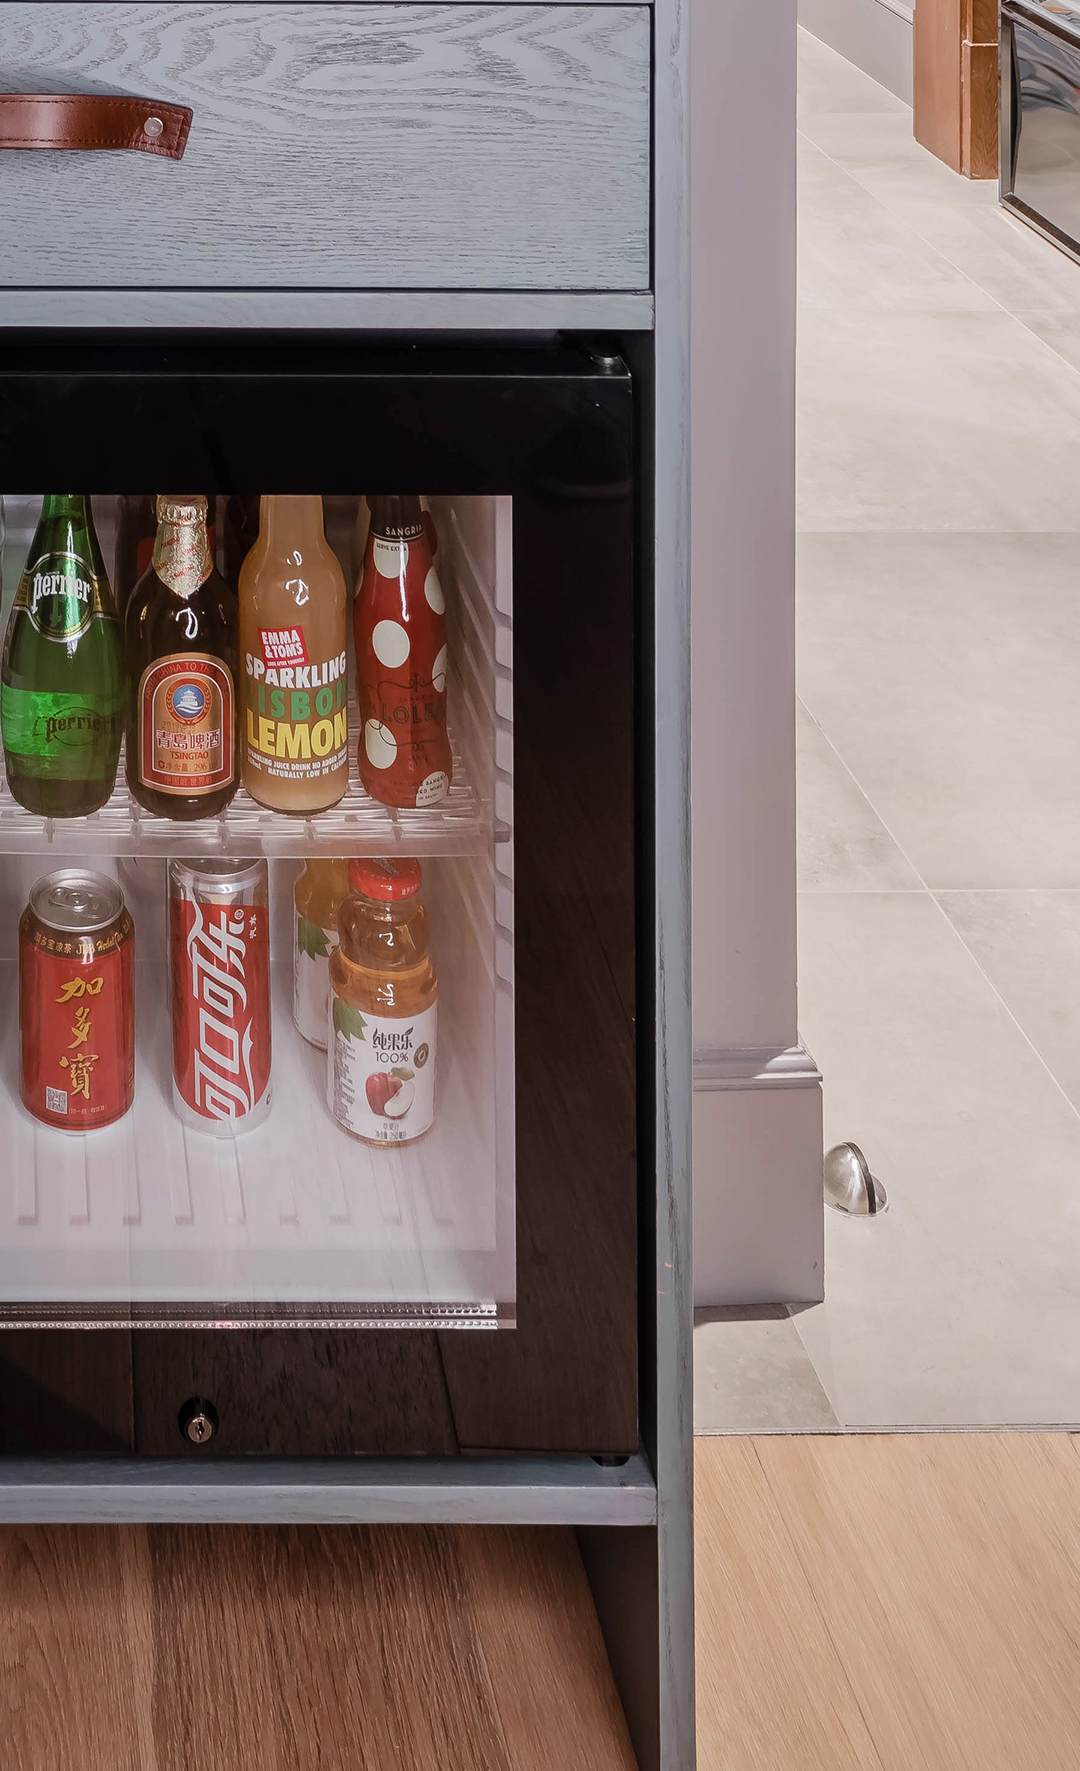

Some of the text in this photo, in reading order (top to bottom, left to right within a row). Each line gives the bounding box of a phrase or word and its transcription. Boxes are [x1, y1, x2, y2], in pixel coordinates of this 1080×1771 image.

[261, 629, 300, 645] EMMA
[157, 664, 182, 679] CHINA
[184, 662, 197, 671] TO
[200, 663, 214, 675] THE
[245, 651, 346, 689] SPARKLING
[247, 706, 346, 759] LEMON
[170, 751, 209, 760] TSINGTAO
[267, 767, 304, 779] NATURALLY
[306, 769, 320, 778] LOW
[322, 767, 329, 775] IN
[274, 761, 290, 770] JUICE
[291, 763, 311, 771] DRINK
[312, 761, 321, 769] NO
[372, 1026, 414, 1051] 纯果乐
[376, 1052, 409, 1063] 100%
